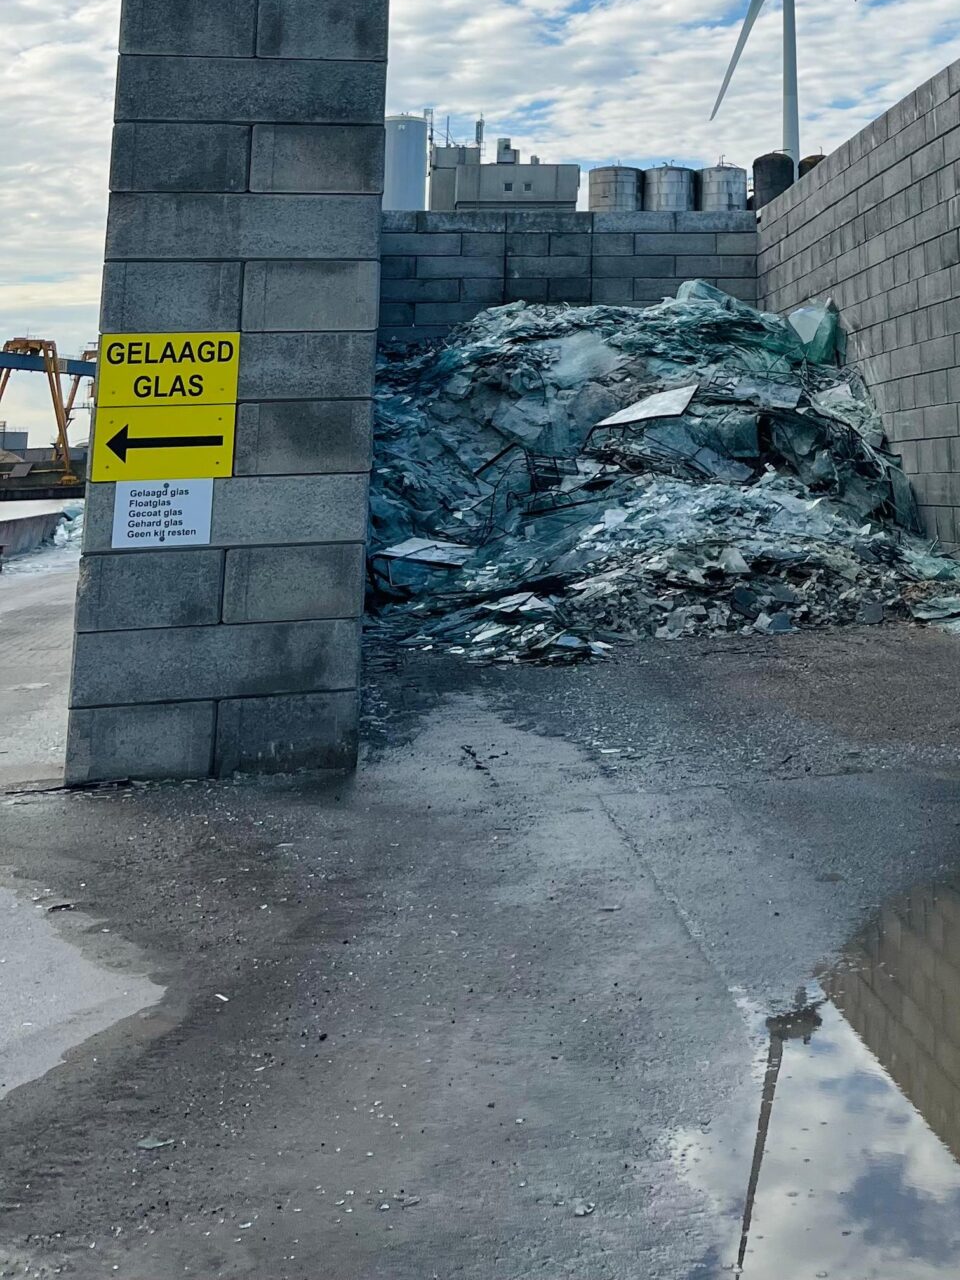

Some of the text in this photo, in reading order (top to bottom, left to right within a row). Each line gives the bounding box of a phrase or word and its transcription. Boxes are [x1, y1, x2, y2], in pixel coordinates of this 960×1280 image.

[106, 340, 233, 365] GELAAGD
[133, 374, 204, 398] GLAS
[130, 488, 189, 498] Gelaagd glas
[129, 499, 171, 508] Floatglas
[128, 508, 182, 517] Gecoat glas
[128, 518, 183, 528] Gehard glas
[127, 530, 151, 538] Geen
[168, 528, 196, 536] resten
